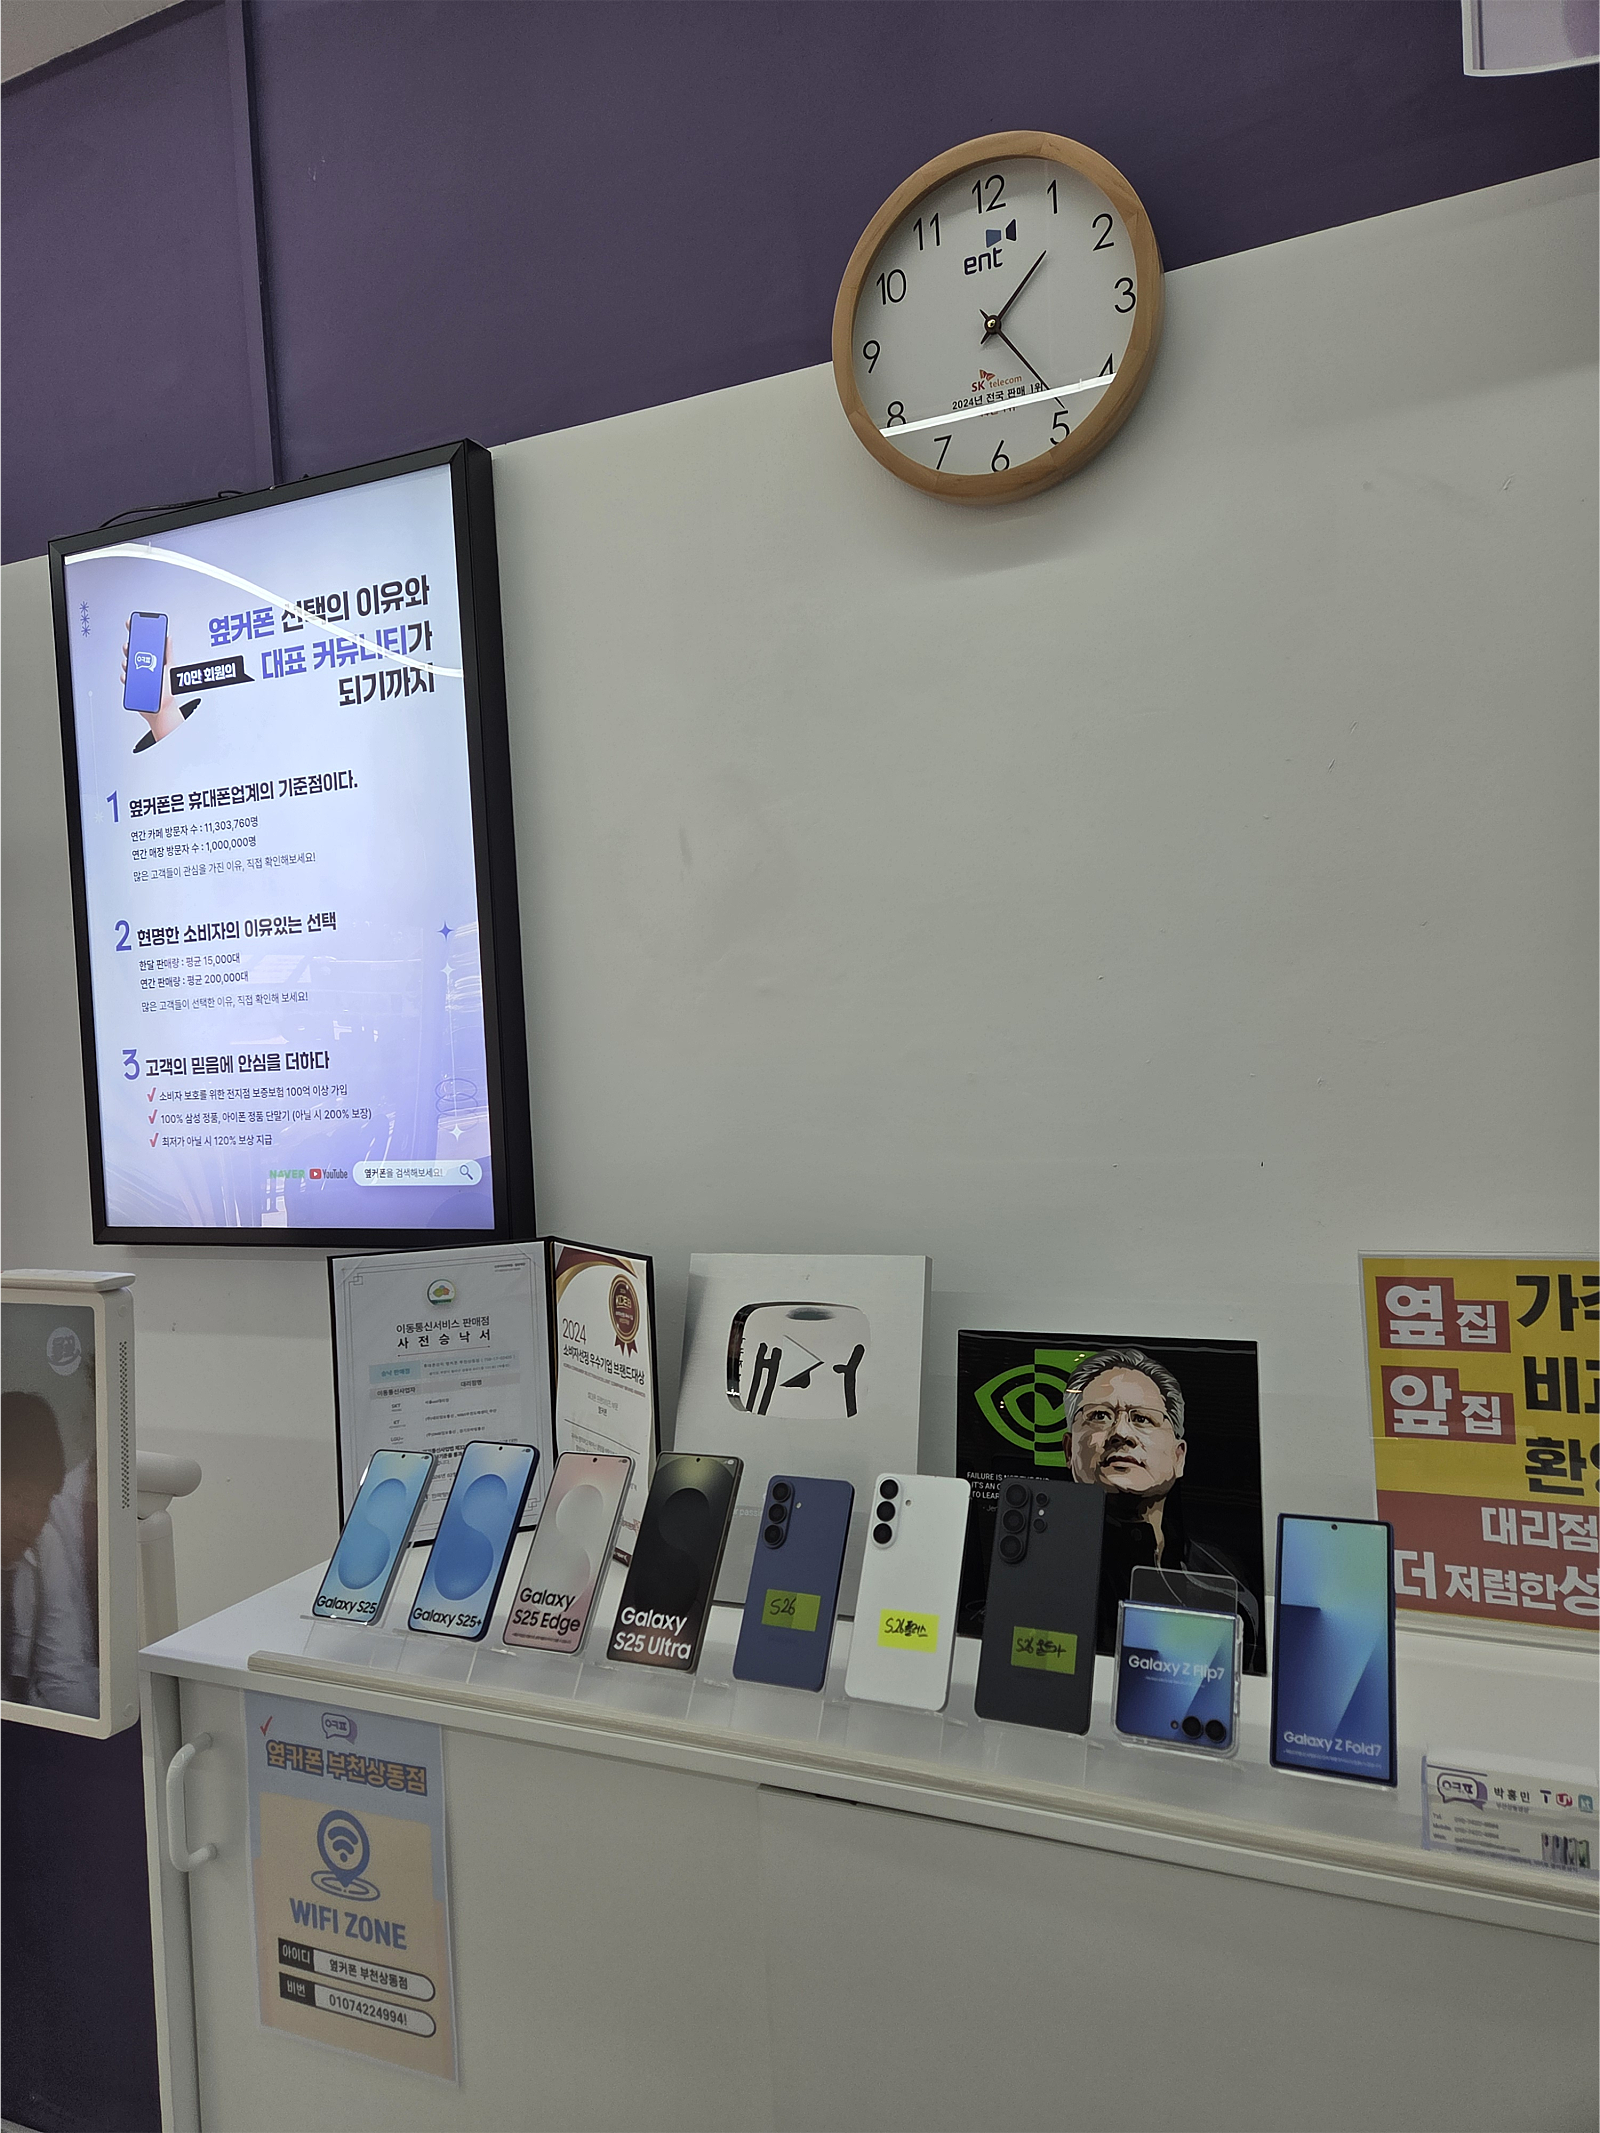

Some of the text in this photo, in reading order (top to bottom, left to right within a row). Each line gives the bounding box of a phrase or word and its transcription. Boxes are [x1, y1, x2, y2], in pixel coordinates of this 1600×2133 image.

[972, 175, 1006, 214] 12
[1047, 180, 1059, 214] 1
[913, 213, 940, 250] 11
[1091, 213, 1114, 251] 2
[964, 248, 1003, 275] ent
[876, 269, 907, 305] 10
[1114, 277, 1136, 313] 3
[862, 340, 880, 373] 9
[952, 396, 982, 410] 2024년
[987, 391, 1003, 403] 전국
[1008, 386, 1025, 398] 판매
[972, 376, 1022, 392] SK telecom
[886, 401, 907, 427] 8
[1050, 410, 1070, 445] 5
[934, 435, 952, 470] 7
[991, 440, 1009, 472] 6
[209, 575, 429, 646] 옆커폰 선택의 이유와
[262, 621, 432, 679] 대표 커뮤니티가
[177, 663, 236, 687] 70만 회원의
[339, 663, 434, 706] 되기까지
[106, 790, 119, 822] 1
[130, 770, 358, 818] 옆커폰은 휴대폰업계의 기준점이다.
[131, 831, 146, 842] 연간
[148, 828, 163, 839] 카페
[165, 825, 188, 838] 방문자
[204, 816, 258, 833] 11,303,760명
[132, 849, 147, 861] 연간
[149, 847, 164, 858] 매장
[166, 844, 189, 856] 방문자
[206, 835, 256, 851] 1,000,000명
[133, 852, 315, 882] 많은 고객들이 관심을 가진 이유, 직접 확인해보세요!
[115, 920, 132, 951] 2
[137, 912, 336, 947] 현명한 소비자의 이유있는 선택
[139, 952, 240, 971] 한달 판매량 평균 15,000대
[140, 971, 248, 989] 연간 판매량 평균 200,000대
[142, 991, 308, 1012] 많은 고객들이 선택한 이유, 직접 확인해 보세요!
[122, 1049, 139, 1080] 3
[146, 1051, 329, 1076] 고객의 믿음에 안심을 더하다
[160, 1084, 347, 1101] 소비자 보호를 위한 전지점 보증보험 100억 이상 가입
[161, 1114, 183, 1124] 100%
[185, 1113, 200, 1124] 삼성
[203, 1112, 220, 1124] 정품,
[223, 1112, 246, 1123] 아이폰
[249, 1111, 263, 1122] 정품
[266, 1110, 289, 1121] 단말기
[292, 1109, 311, 1122] (아닐
[324, 1109, 349, 1119] 200%
[352, 1108, 371, 1120] 보장)
[162, 1136, 185, 1147] 최저가
[187, 1135, 201, 1147] 아닐
[214, 1135, 236, 1146] 120%
[239, 1134, 254, 1145] 보상
[256, 1134, 272, 1145] 지급
[322, 1169, 348, 1179] YouTube
[364, 1168, 443, 1179] 옆커폰을 검색해보세요!
[396, 1316, 490, 1334] 이동통신서비스 판매점
[562, 1318, 586, 1345] 2024
[563, 1344, 589, 1366] 소비자선정
[590, 1353, 612, 1374] 우수기업
[613, 1367, 645, 1386] 브랜드대상
[1481, 1506, 1598, 1553] 대리점
[316, 1595, 378, 1616] Galaxy S25
[520, 1587, 576, 1610] Galaxy
[770, 1599, 796, 1615] S26
[412, 1607, 482, 1627] Galaxy S25+
[512, 1608, 580, 1636] S25 Edge
[620, 1606, 688, 1635] Galaxy
[613, 1631, 691, 1660] S25 Ultra
[1129, 1654, 1179, 1676] Galaxy
[1193, 1666, 1225, 1682] Flip7
[1284, 1731, 1332, 1753] Galaxy
[1346, 1741, 1382, 1757] Fold7
[327, 1749, 428, 1796] 부천상동점
[289, 1898, 407, 1951] WIFI ZONE
[282, 1943, 311, 1965] 아이디
[329, 1957, 408, 1990] 옆커폰 부천상동점
[287, 1980, 306, 1998] 비번
[329, 1993, 407, 2026] 01074224994!
